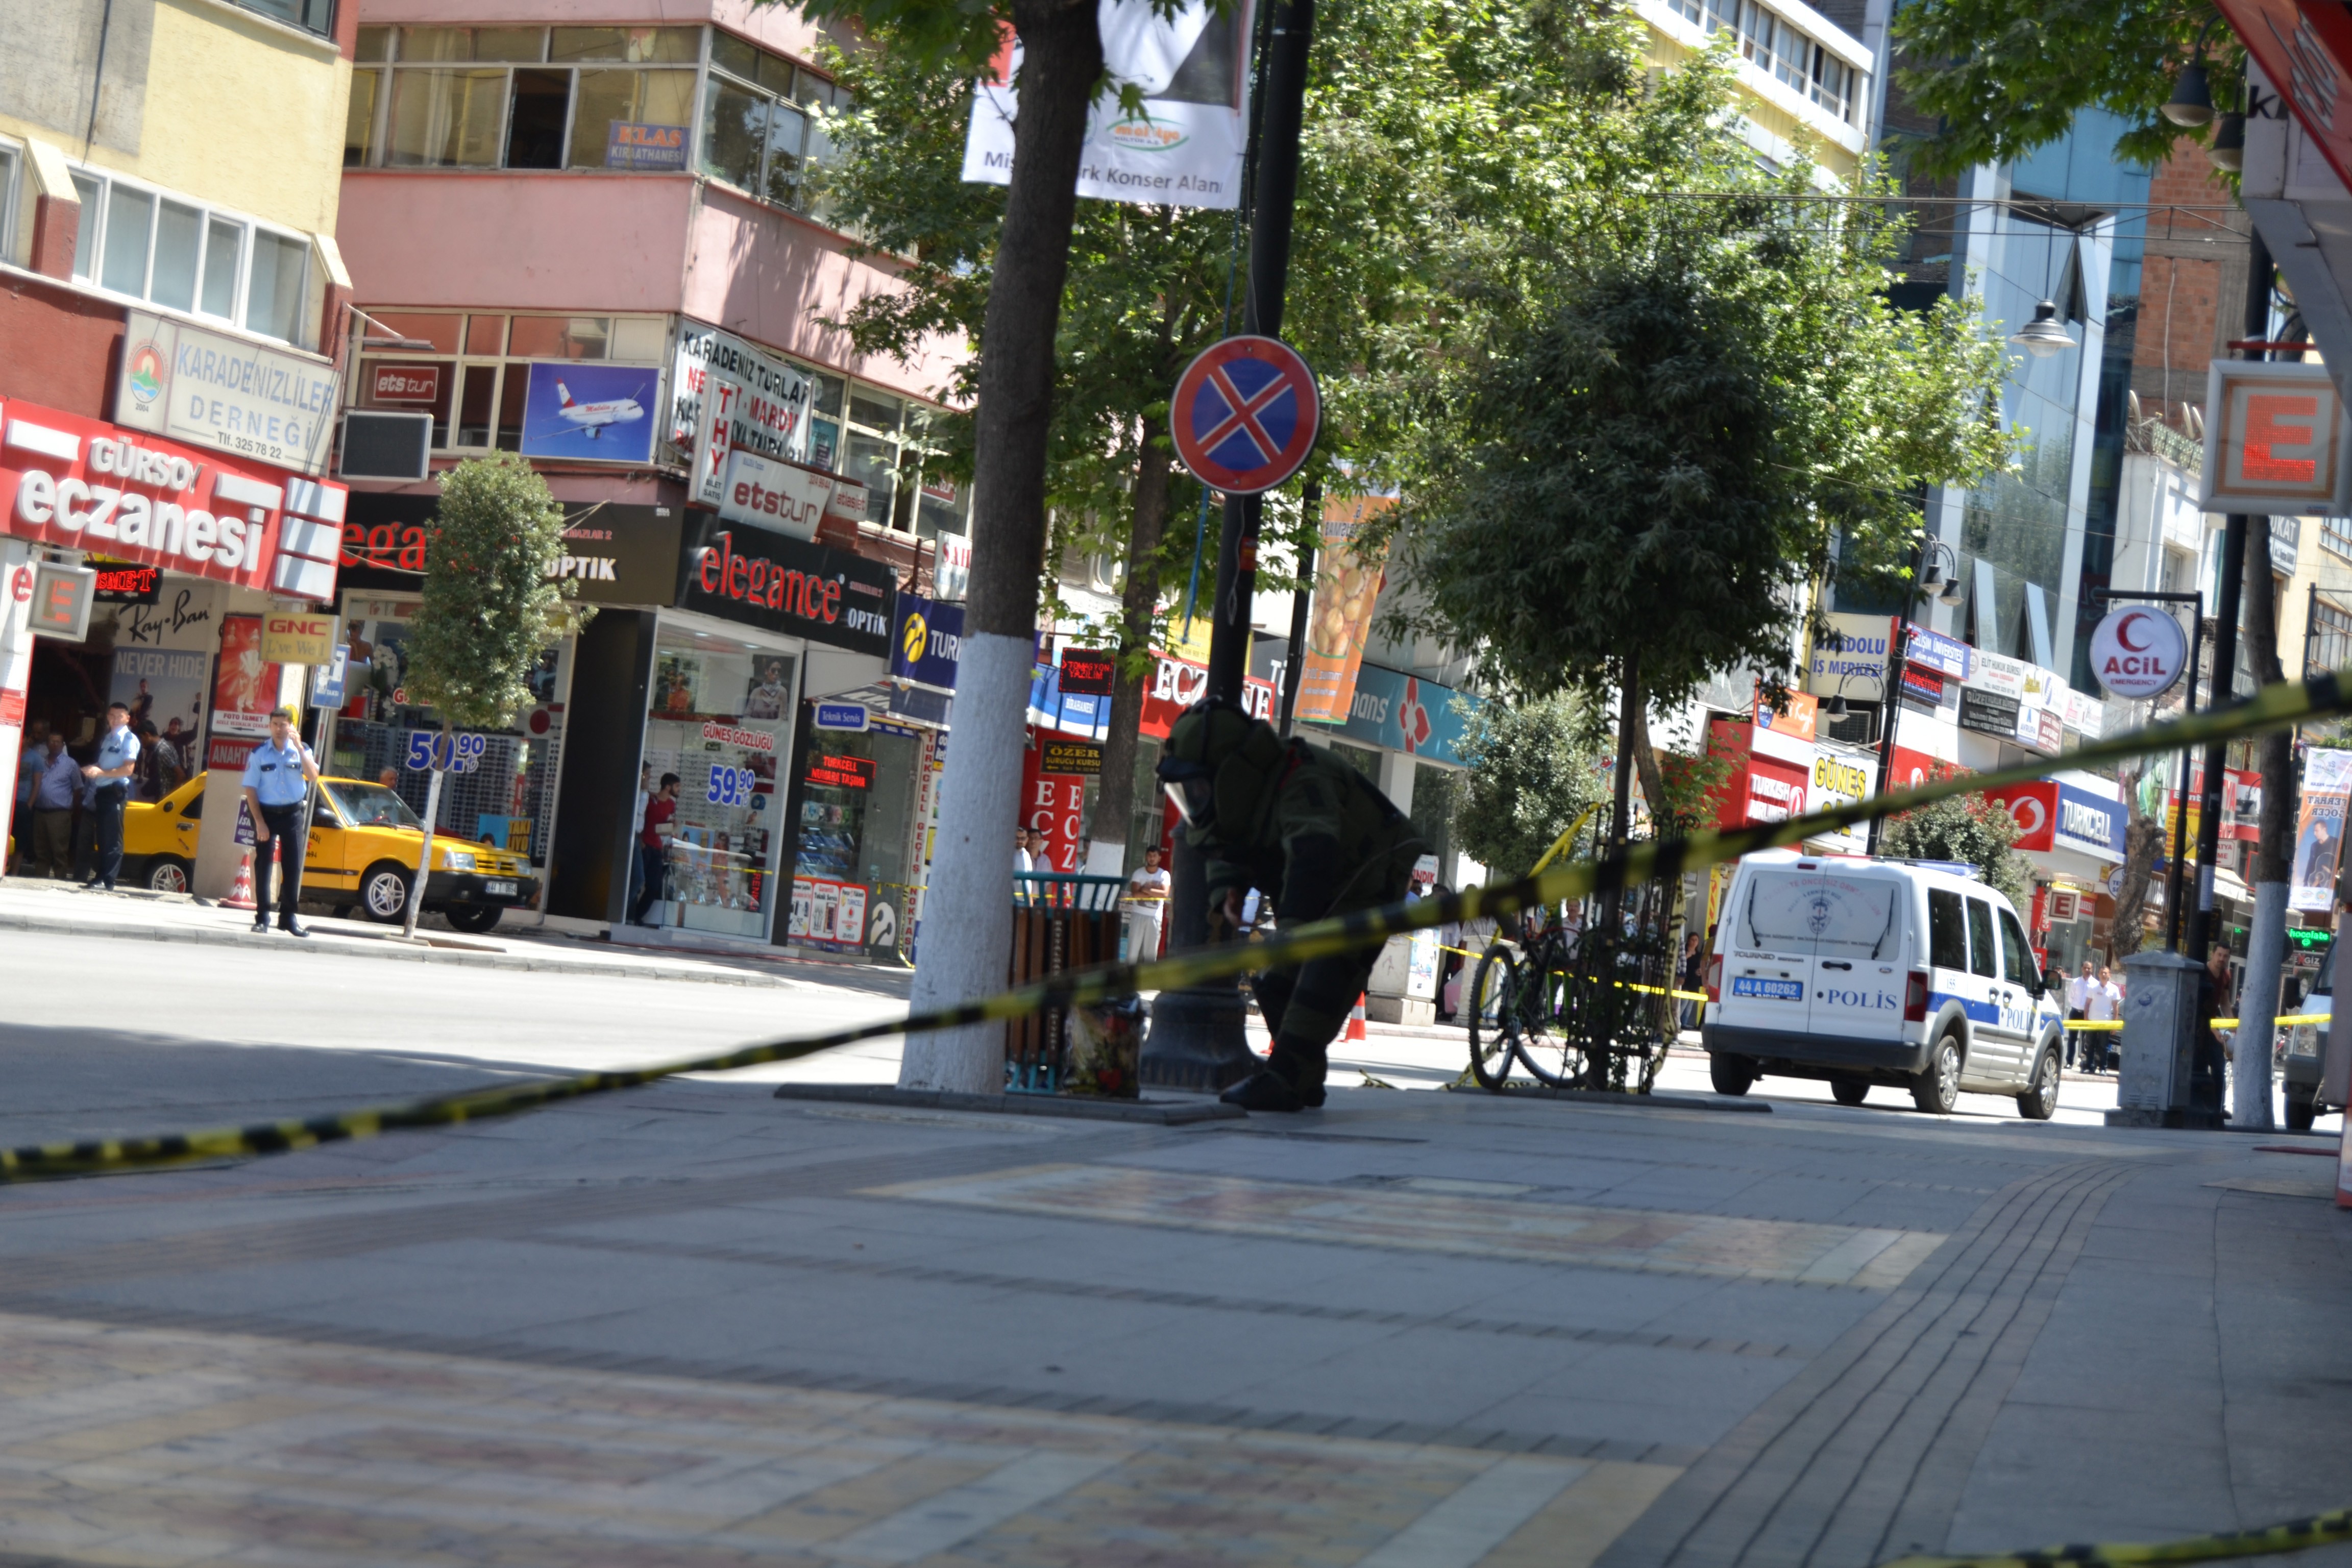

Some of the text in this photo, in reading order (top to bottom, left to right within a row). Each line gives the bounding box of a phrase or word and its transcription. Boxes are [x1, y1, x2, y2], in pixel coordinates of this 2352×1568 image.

[618, 126, 682, 148] KLAS
[1107, 167, 1173, 189] Konser
[683, 331, 755, 382] KARADENİZ
[178, 342, 335, 416] KARADENİZLİLER
[135, 403, 149, 412] 2004
[189, 395, 312, 451] DERNEĞİ
[235, 436, 254, 453] 325
[255, 442, 267, 456] 78
[270, 446, 282, 459] 22
[2242, 395, 2317, 482] E
[90, 436, 204, 494] GÜRSOY
[837, 491, 866, 512] atlasjet
[18, 470, 265, 571] eczanesi
[604, 530, 612, 540] 2
[700, 530, 841, 624] elegance
[268, 619, 328, 636] GNC
[847, 607, 887, 636] OPTİK
[115, 651, 204, 679] NEVER HIDE
[1813, 655, 1825, 677] İŞ
[2103, 656, 2166, 675] ACİL
[241, 712, 264, 722] İSMET
[822, 710, 861, 723] Teknik Servis
[702, 720, 773, 751] GÜNEŞ GÖZLÜĞÜ
[1049, 745, 1100, 758] ÖZER
[1076, 758, 1101, 767] KURSU
[1750, 773, 1791, 802] TURKISH
[1814, 754, 1867, 803] GÜNEŞ
[2062, 798, 2112, 843] TURKCELL
[2054, 895, 2071, 915] E
[1738, 979, 1797, 995] 44 A 60262
[1827, 989, 1897, 1010] POLİS
